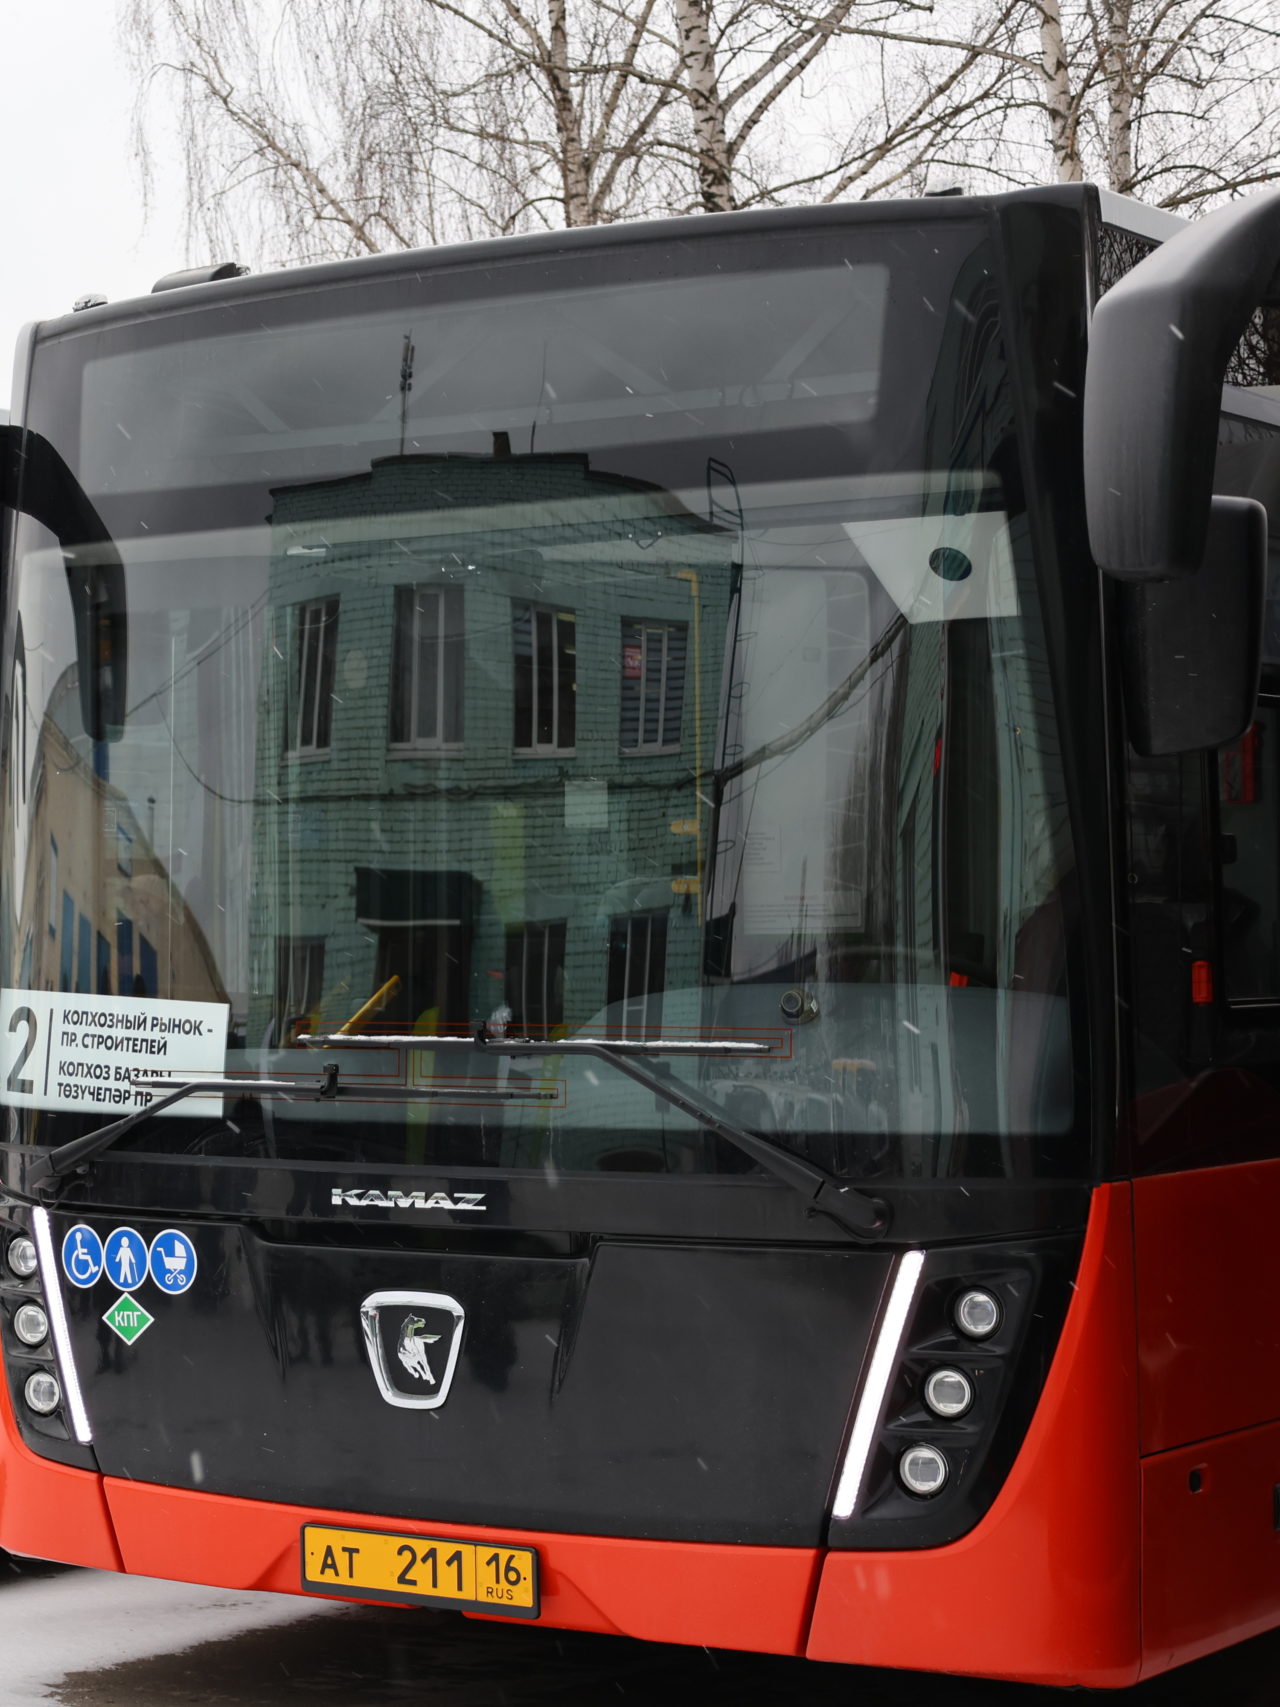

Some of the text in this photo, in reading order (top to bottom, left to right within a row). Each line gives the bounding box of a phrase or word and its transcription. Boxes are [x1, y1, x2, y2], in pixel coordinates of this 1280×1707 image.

[62, 1009, 147, 1032] КОЛХОЗНЫЙ
[150, 1016, 203, 1036] РЫНОК
[7, 1006, 38, 1094] 2
[61, 1031, 168, 1056] ПР. СТРОИТЕЛЕЙ
[58, 1060, 111, 1080] КОЛХОЗ
[57, 1082, 131, 1105] ТӨЗҮЧЕЛӘР
[331, 1188, 487, 1211] KAMAZ
[114, 1310, 142, 1327] КПГ
[396, 1544, 463, 1592] 211
[485, 1552, 521, 1587] 16
[486, 1586, 514, 1600] RUS
